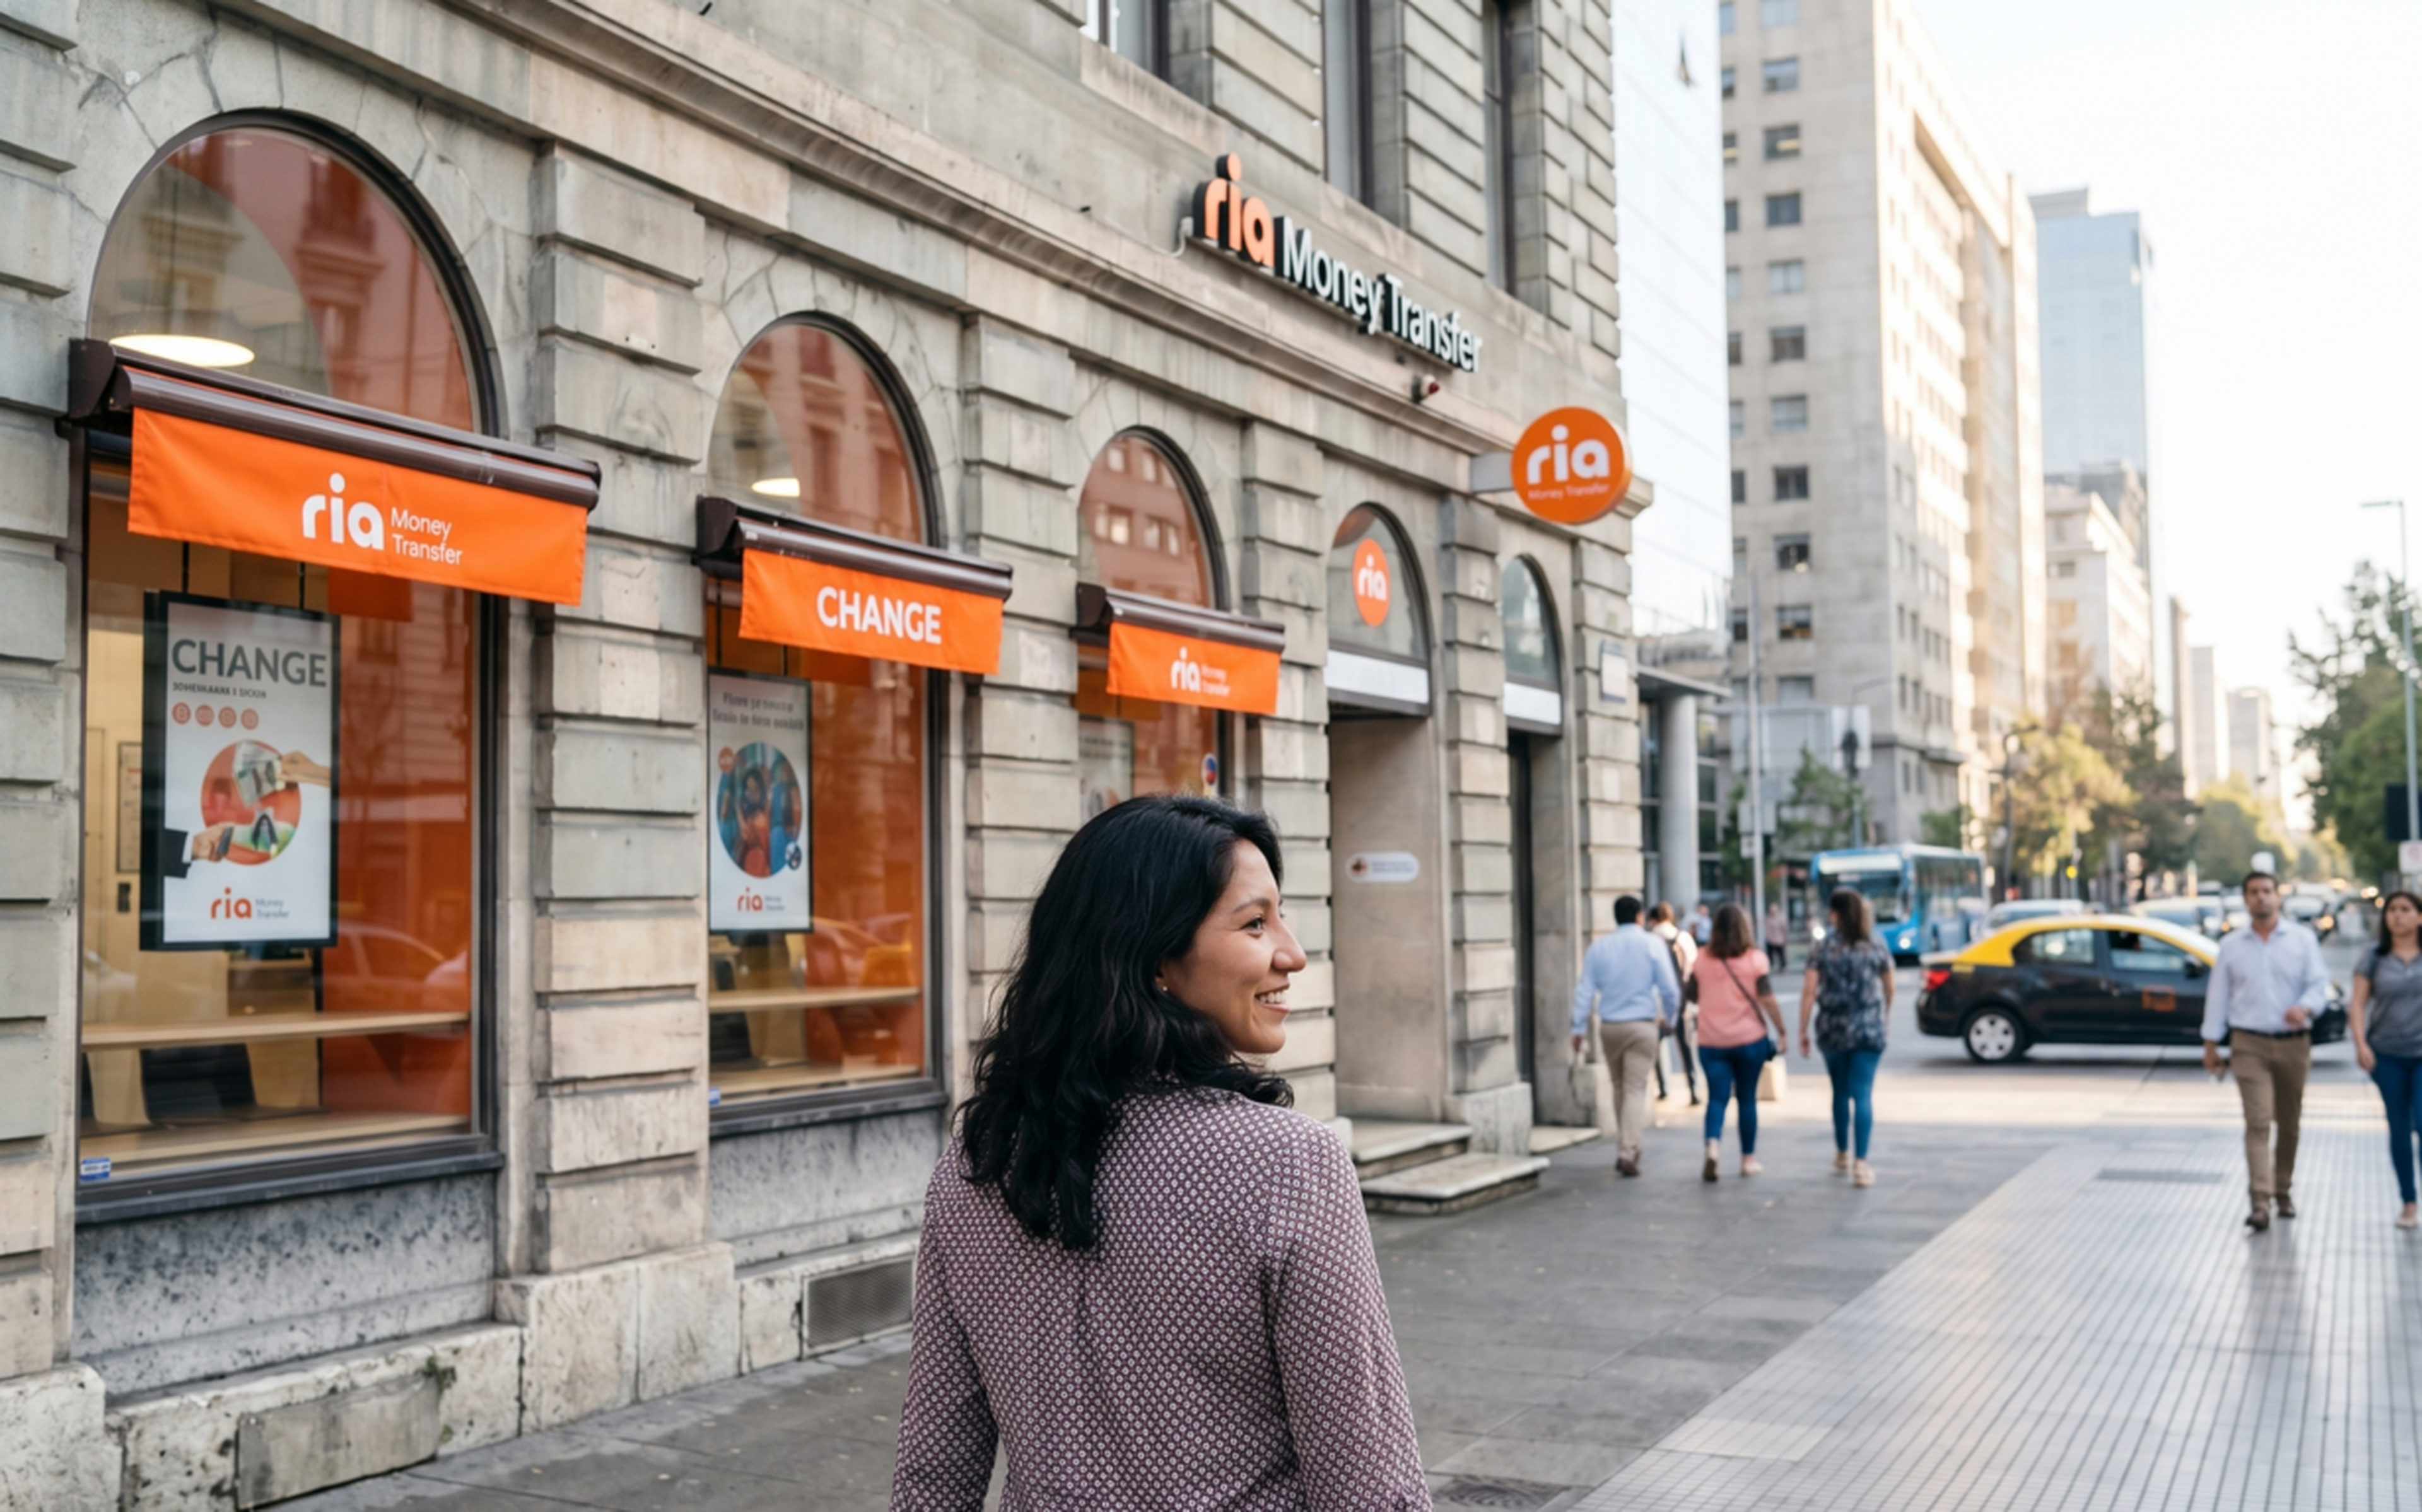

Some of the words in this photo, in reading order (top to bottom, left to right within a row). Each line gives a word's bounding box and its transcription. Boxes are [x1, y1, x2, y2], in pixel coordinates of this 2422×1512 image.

[1203, 153, 1275, 268] ria
[1283, 215, 1384, 334] Money
[1385, 272, 1483, 373] Transfer
[1527, 424, 1610, 485] ria
[302, 472, 385, 551] ria
[390, 506, 452, 543] Money
[392, 533, 464, 565] Transfer
[1357, 554, 1388, 602] ria
[816, 586, 942, 644] CHANGE
[171, 638, 327, 688] CHANGE
[1171, 646, 1200, 693] ria
[210, 887, 252, 919] ria
[737, 886, 763, 912] ria
